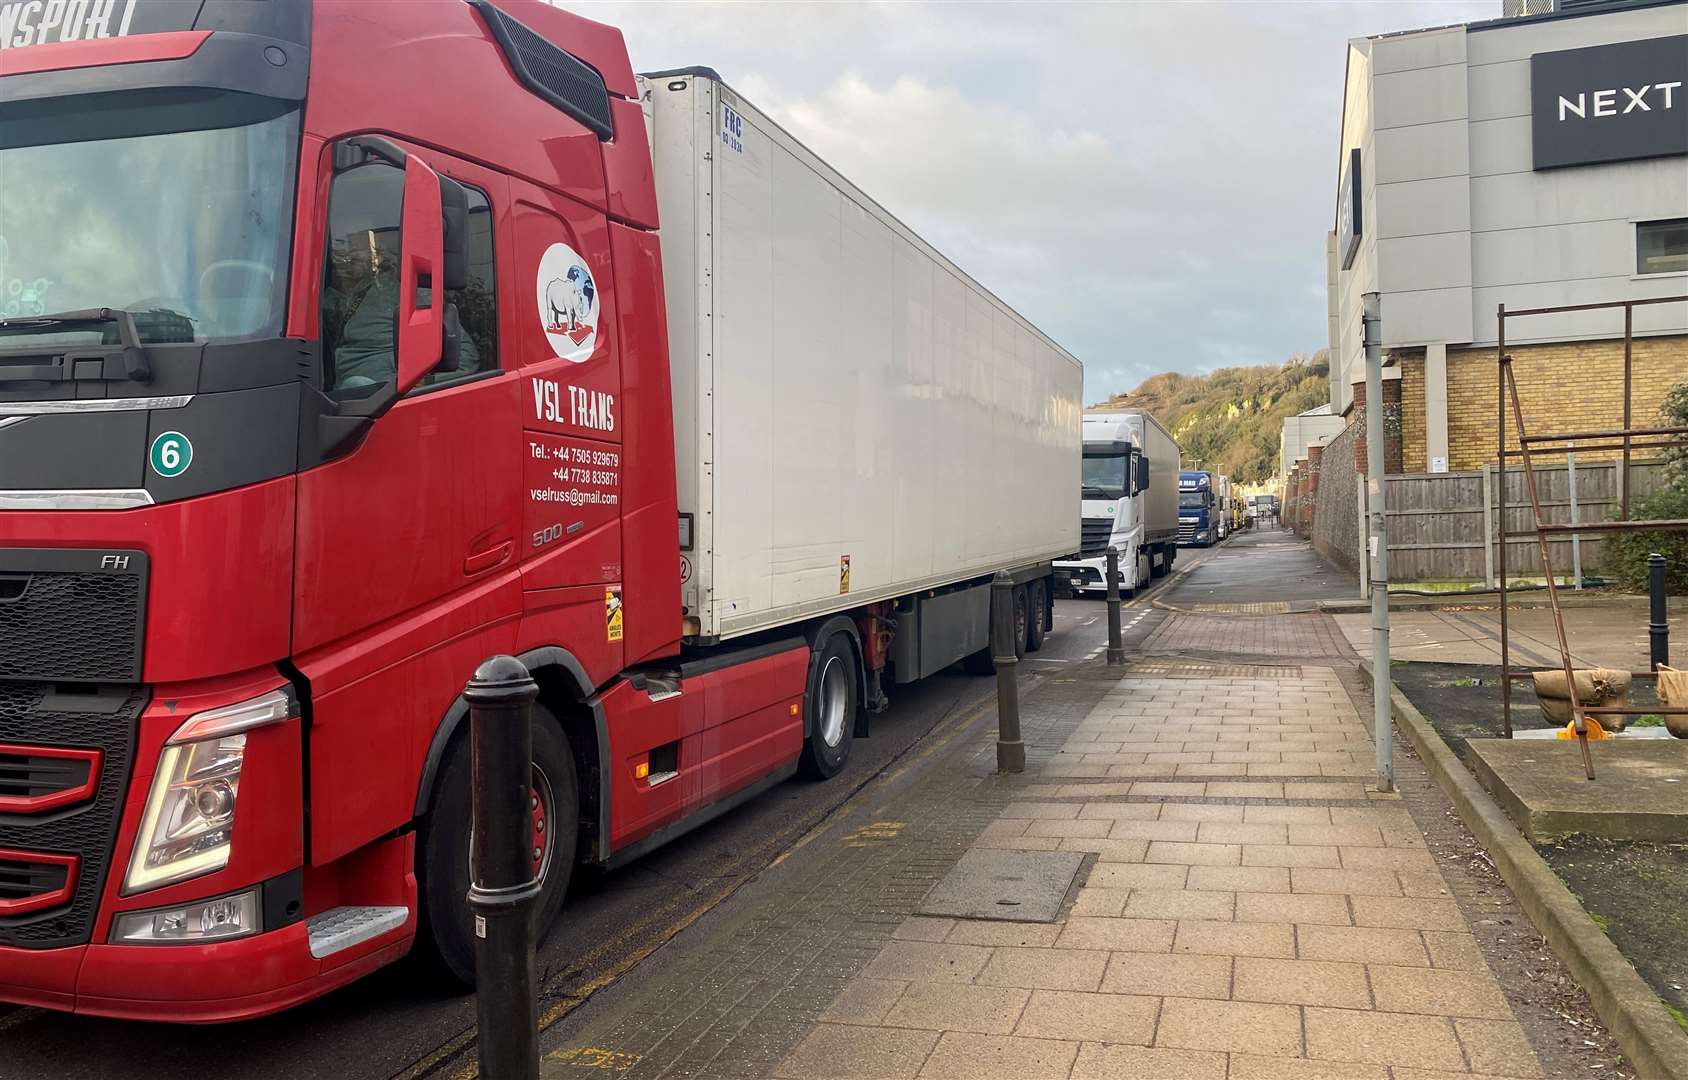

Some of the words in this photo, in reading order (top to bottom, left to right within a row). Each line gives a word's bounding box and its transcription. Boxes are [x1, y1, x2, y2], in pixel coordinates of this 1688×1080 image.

[1559, 82, 1682, 121] NEXT
[725, 107, 741, 137] FRC
[532, 377, 565, 423] VSL
[568, 385, 614, 432] TRANS
[161, 440, 181, 469] 6
[529, 442, 551, 460] Tel.:
[552, 446, 570, 462] +44
[571, 448, 591, 464] 7505
[592, 451, 619, 467] 929679
[552, 467, 569, 482] +44
[571, 468, 591, 484] 7738
[592, 470, 618, 486] 835871
[530, 486, 618, 506] vselruss@gmail.com
[532, 523, 562, 547] 500
[100, 555, 129, 569] FH
